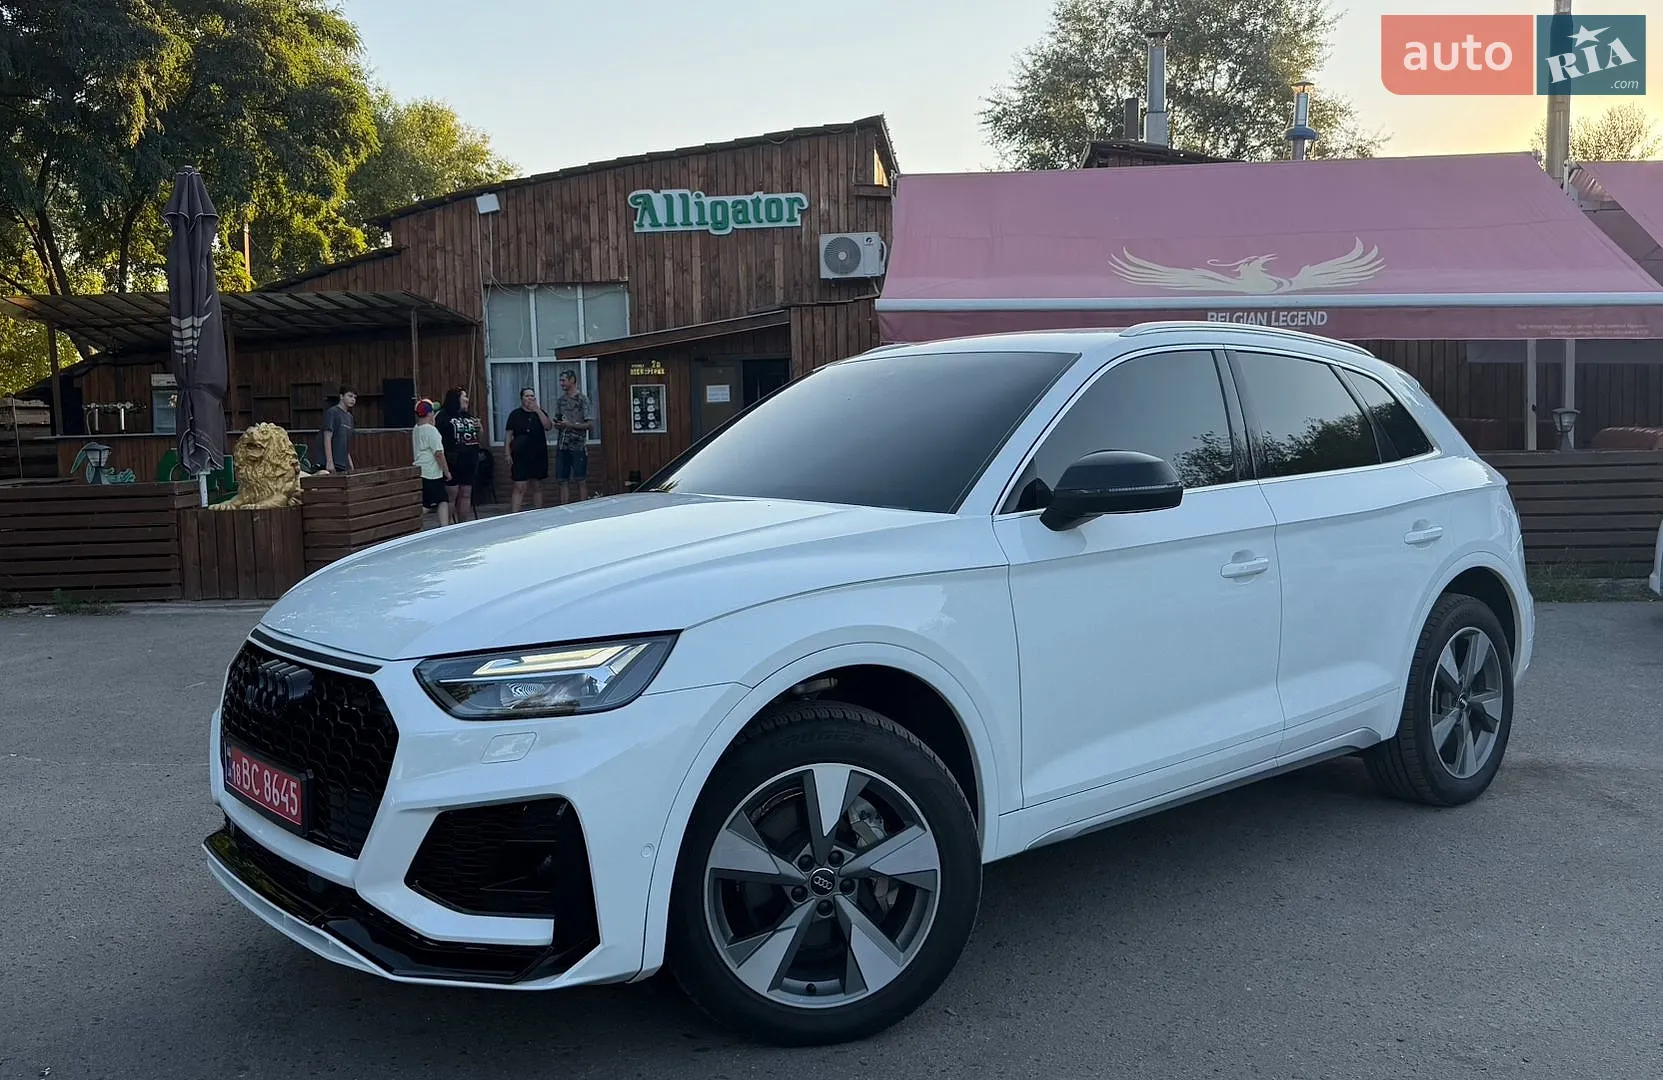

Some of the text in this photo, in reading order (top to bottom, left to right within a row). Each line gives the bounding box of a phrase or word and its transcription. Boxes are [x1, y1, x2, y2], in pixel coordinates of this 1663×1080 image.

[630, 192, 806, 231] Alligator
[1207, 310, 1328, 326] BELGIAN LEGEND
[263, 769, 298, 817] 8645
